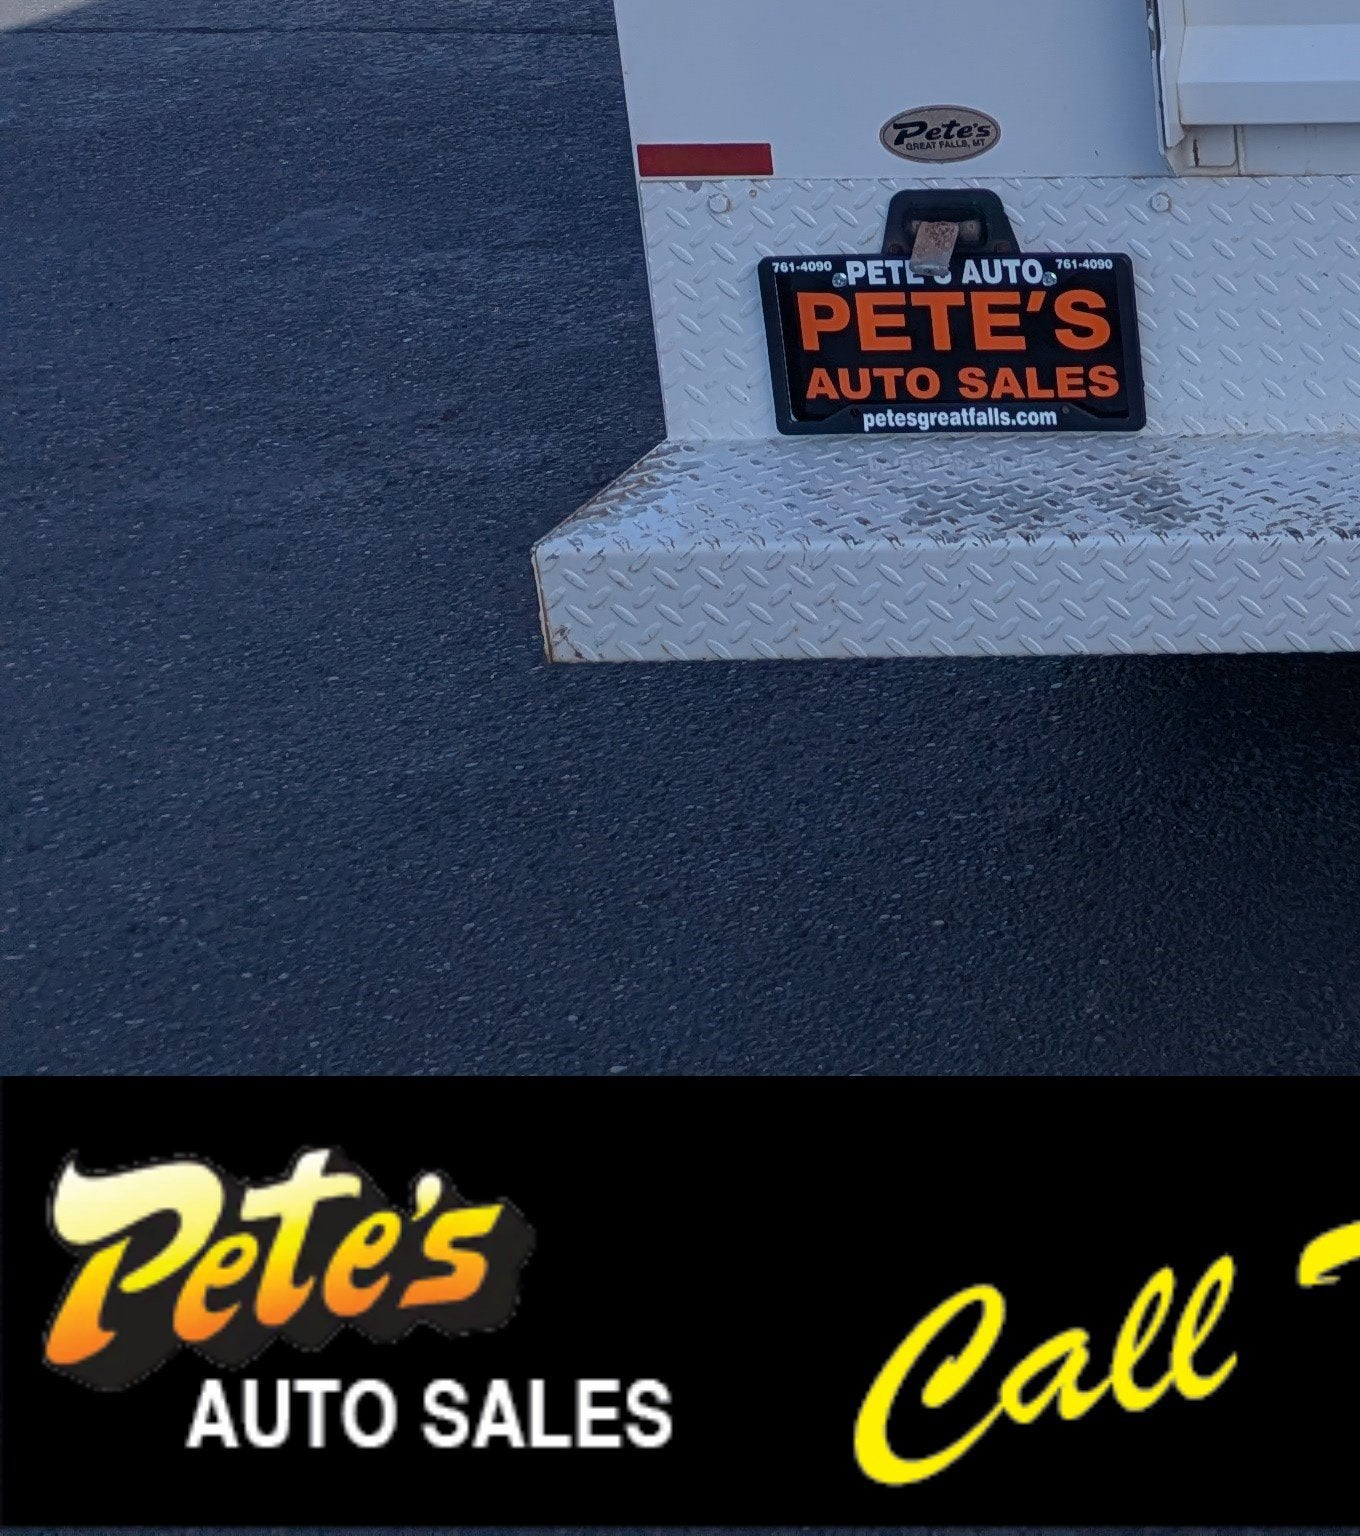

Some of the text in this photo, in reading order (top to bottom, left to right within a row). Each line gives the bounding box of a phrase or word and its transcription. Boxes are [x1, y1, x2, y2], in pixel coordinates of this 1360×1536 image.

[893, 118, 991, 146] Pete's
[905, 141, 937, 151] GREAT
[973, 138, 986, 147] MT
[772, 261, 832, 273] 761-4090
[962, 259, 1043, 284] AUTO
[1055, 258, 1113, 270] 761-4090
[797, 290, 1111, 351] PETE'S
[806, 366, 1119, 399] AUTO SALES
[863, 408, 1058, 432] petesgreatfalls.com
